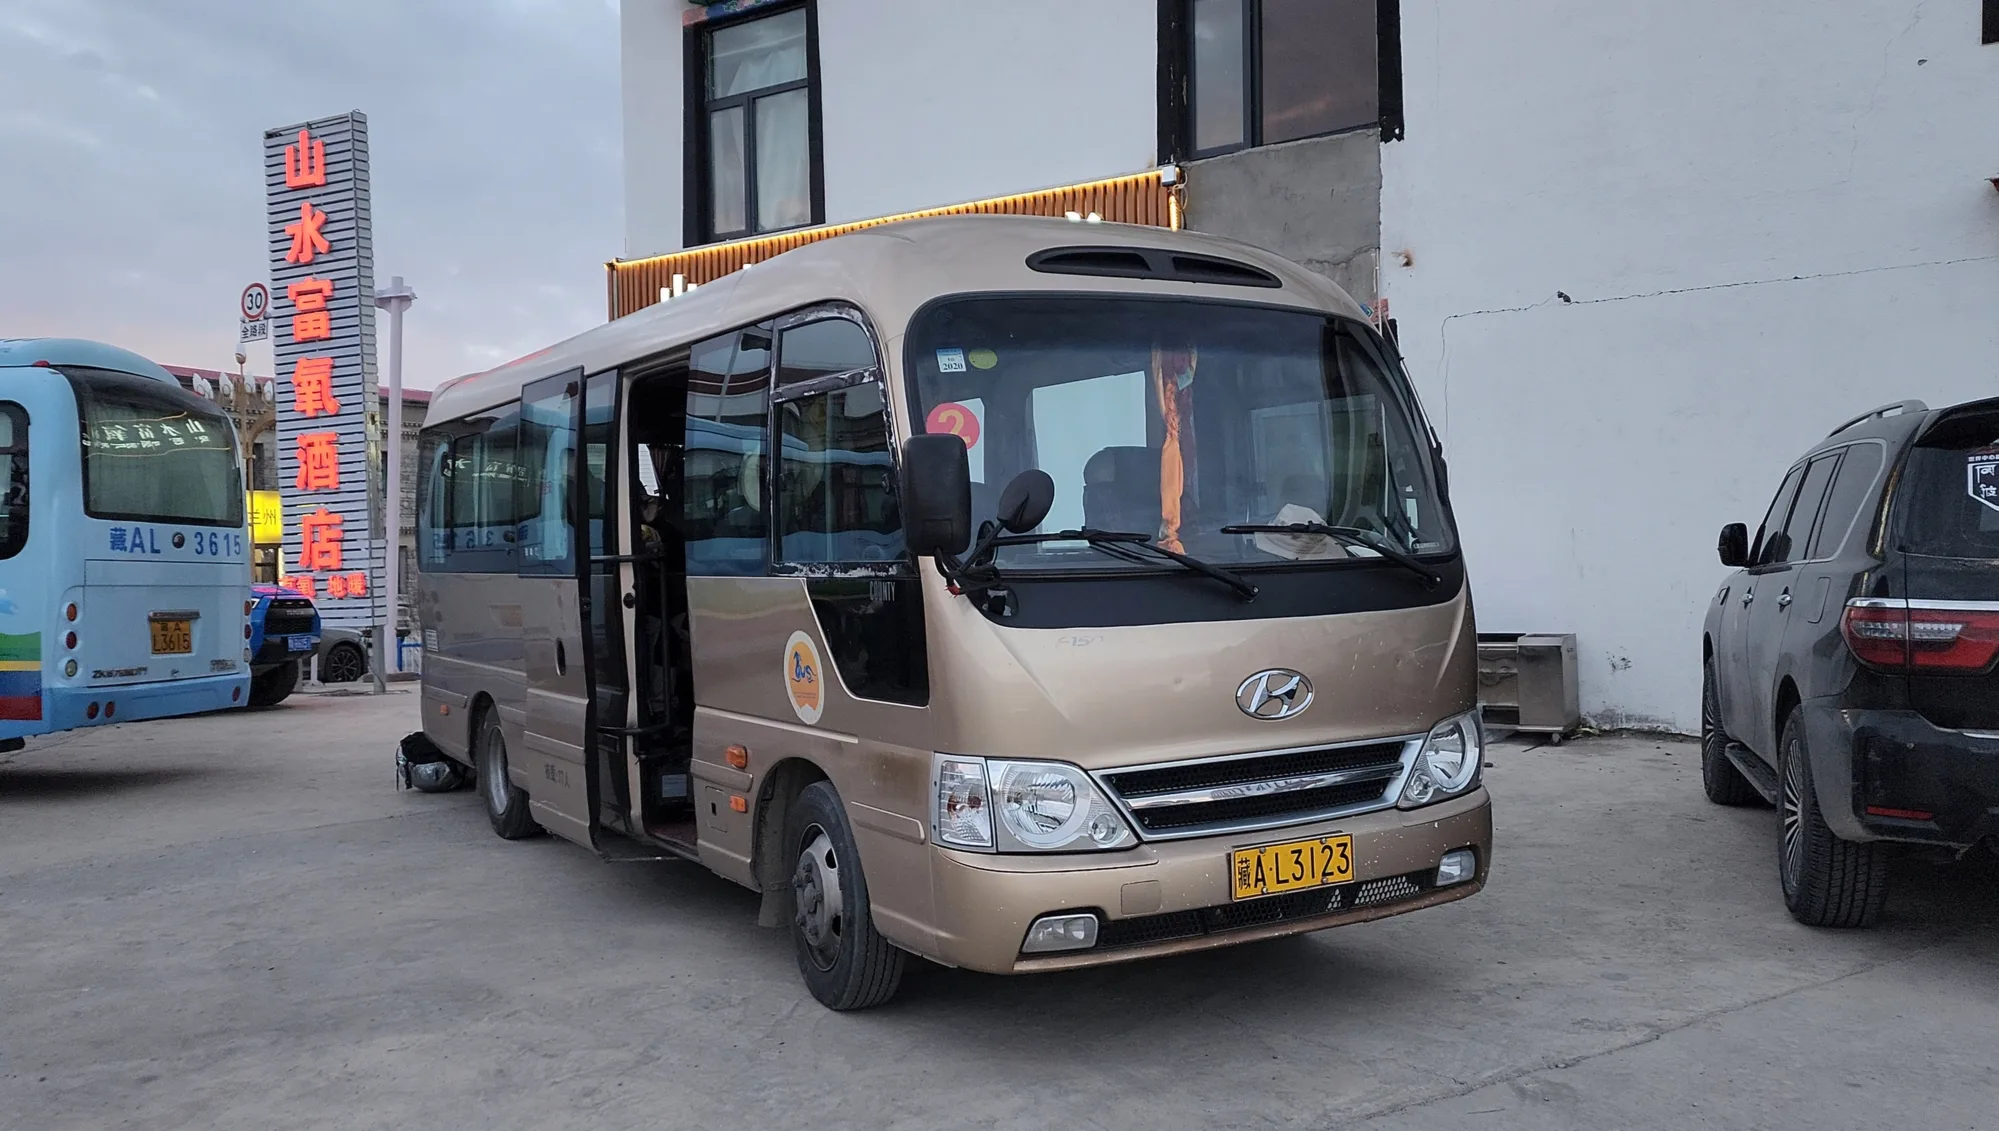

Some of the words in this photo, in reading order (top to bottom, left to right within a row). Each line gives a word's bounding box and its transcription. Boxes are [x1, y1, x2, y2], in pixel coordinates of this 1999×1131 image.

[247, 292, 262, 310] 30
[285, 128, 345, 571] 山水富氧酒店
[943, 362, 964, 371] 2020
[938, 409, 971, 443] 2
[109, 526, 161, 554] 藏AL
[194, 531, 241, 556] 3615
